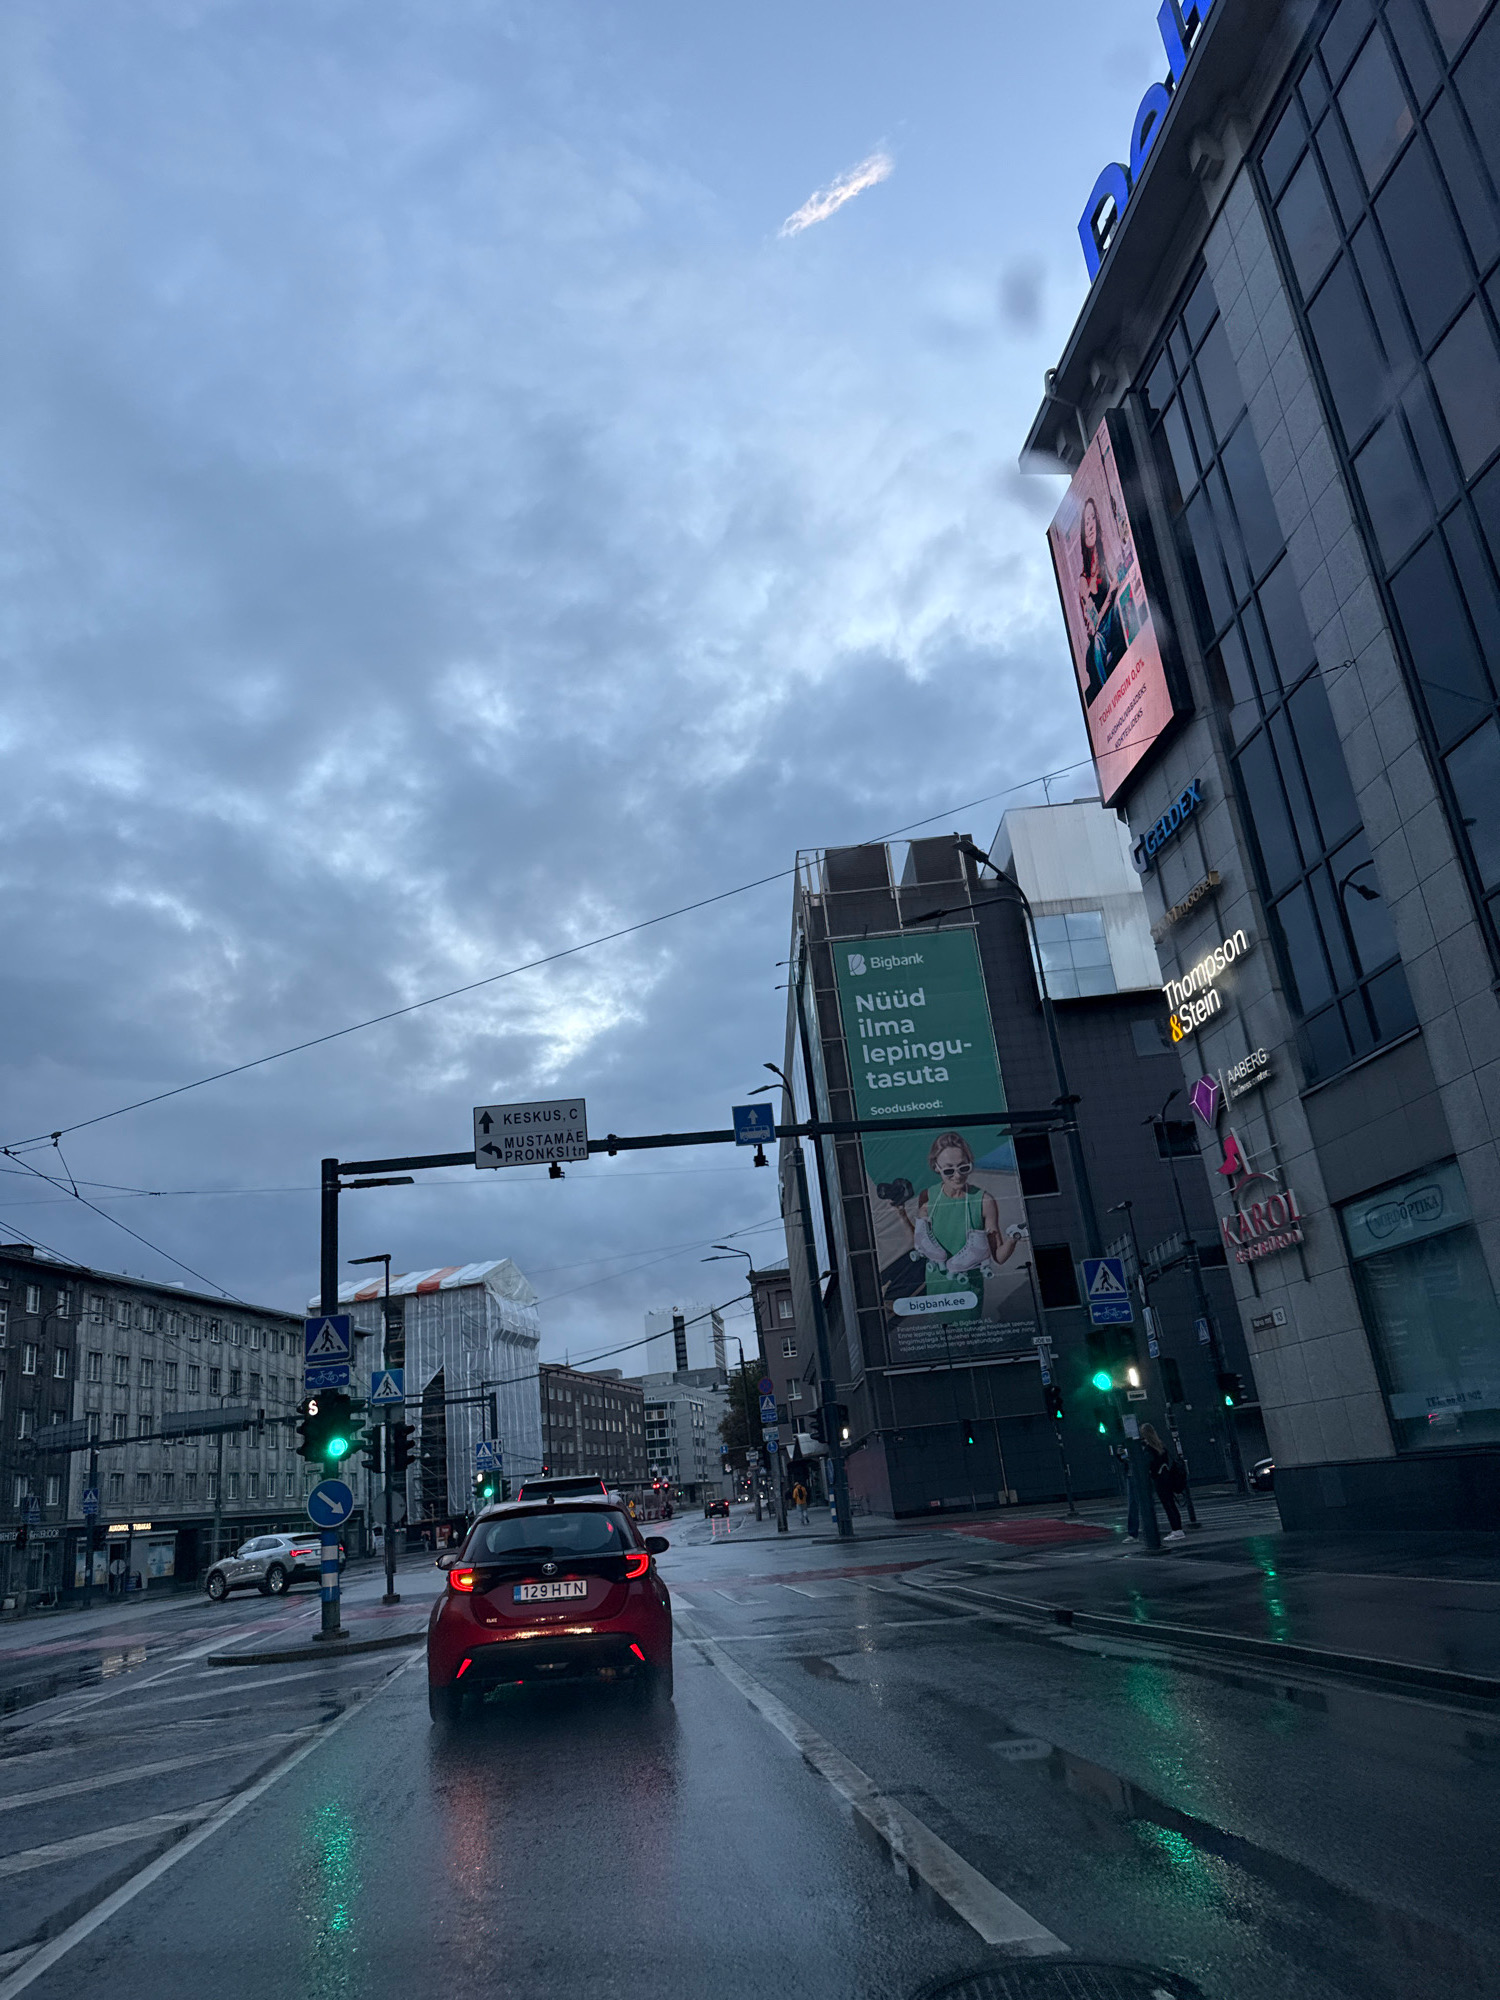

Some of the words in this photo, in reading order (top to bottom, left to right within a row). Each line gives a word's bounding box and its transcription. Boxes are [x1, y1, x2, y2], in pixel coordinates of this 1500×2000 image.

[1099, 703, 1113, 726] TOHI
[1112, 676, 1131, 708] VIRGIN
[1145, 779, 1201, 855] GELDEX
[870, 953, 925, 971] Bigbank
[1161, 929, 1248, 1011] Thompson
[855, 987, 926, 1013] Nüüd
[1169, 988, 1221, 1042] &Stein
[858, 1018, 915, 1038] ilma
[862, 1039, 972, 1066] lepingu-
[866, 1066, 949, 1089] tasuta
[1227, 1047, 1267, 1085] AABERG
[503, 1109, 566, 1125] KESKUS,
[570, 1108, 578, 1119] C
[870, 1100, 944, 1116] Sooduskood:
[504, 1129, 584, 1149] MUSTAMÄE
[505, 1146, 569, 1162] PRONKSI
[573, 1147, 586, 1157] tn
[1222, 1189, 1302, 1248] KAROL
[909, 1297, 966, 1311] bigbank.ee
